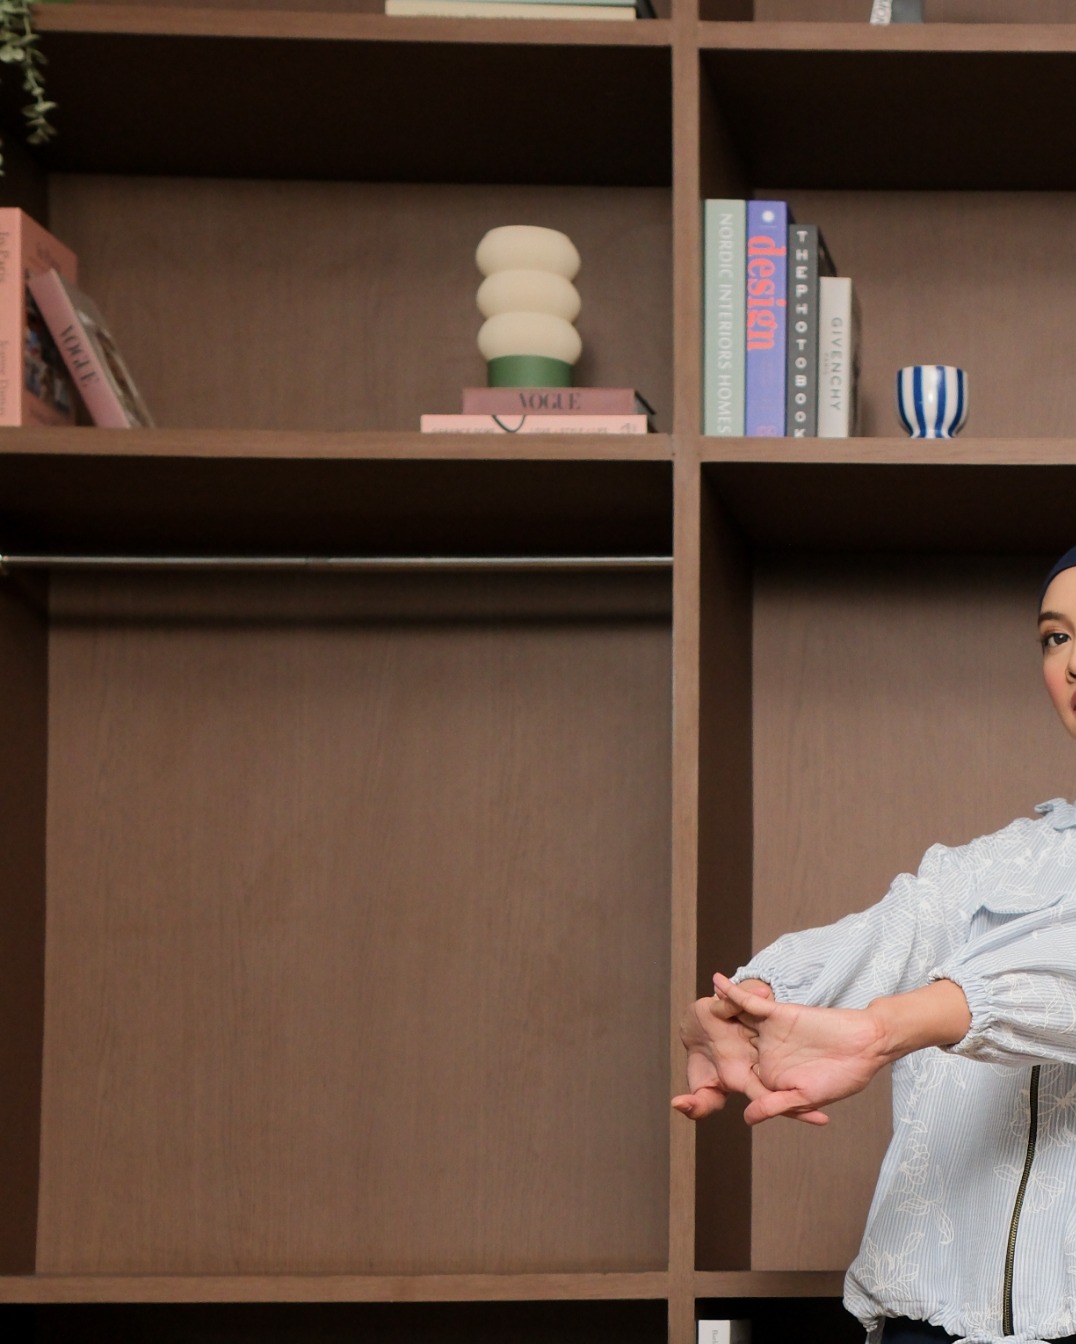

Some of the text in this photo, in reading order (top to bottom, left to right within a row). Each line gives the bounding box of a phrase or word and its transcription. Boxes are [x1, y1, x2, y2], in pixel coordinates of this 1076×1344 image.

[717, 213, 733, 434] NORDIC INTERIORS HOMES
[747, 235, 787, 350] design
[61, 324, 99, 385] VOGUE
[519, 393, 581, 410] VOGUE
[830, 317, 843, 411] GIVENCHY
